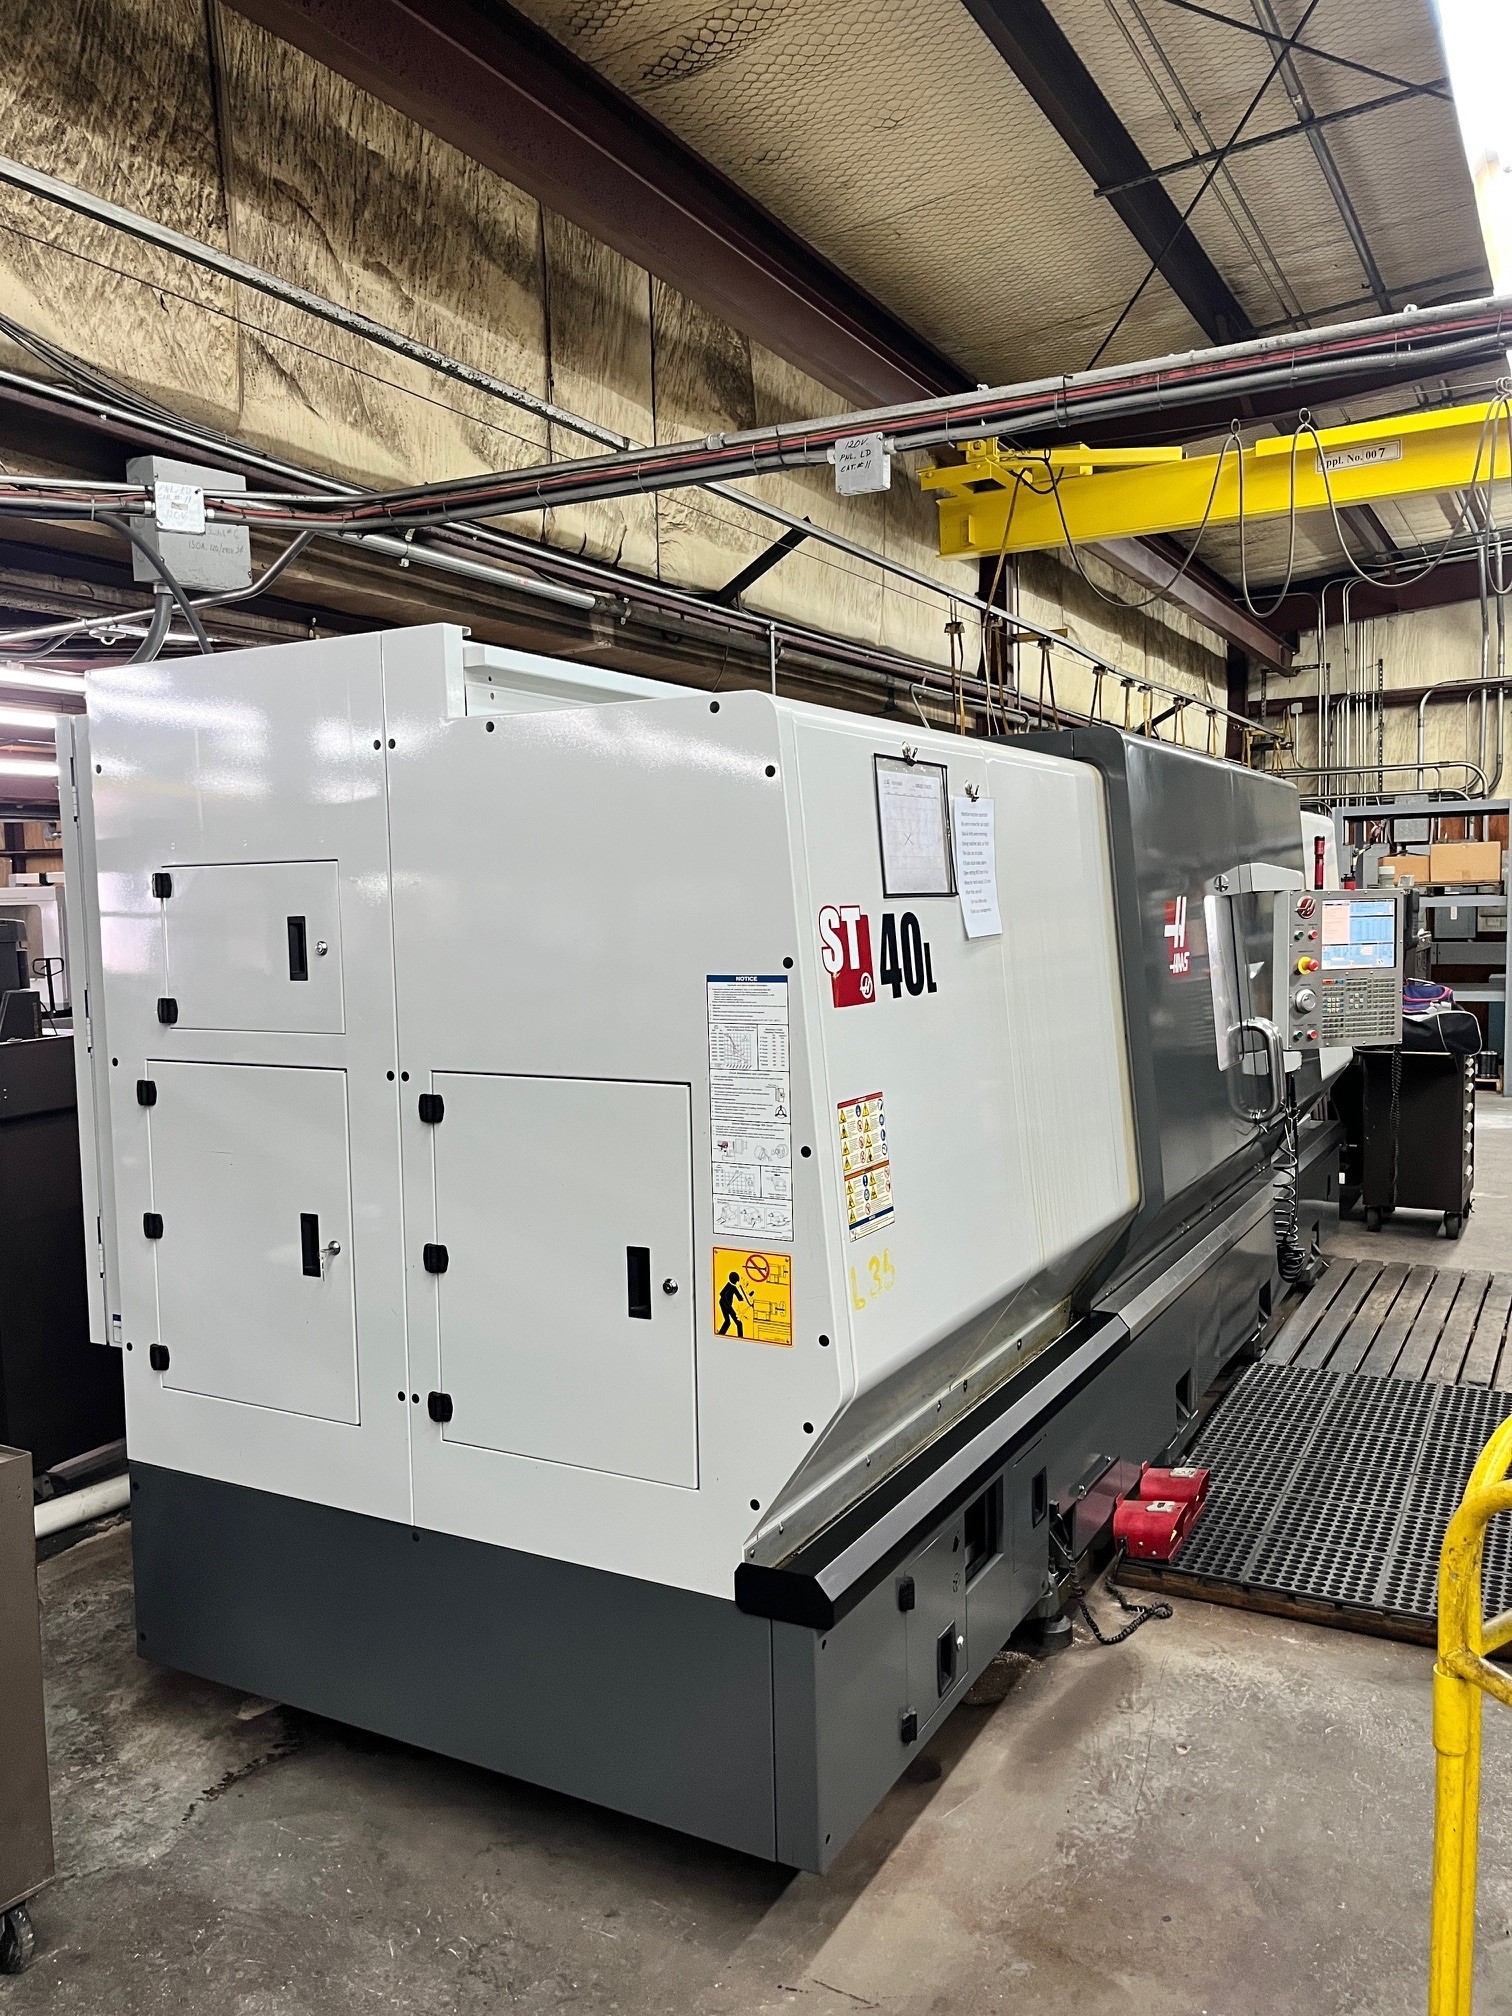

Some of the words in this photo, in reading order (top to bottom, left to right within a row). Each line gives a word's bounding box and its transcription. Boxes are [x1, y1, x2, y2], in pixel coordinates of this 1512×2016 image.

[845, 438, 868, 449] 120V
[860, 449, 871, 458] LD
[1346, 453, 1363, 463] No.
[1365, 447, 1386, 460] 007
[818, 904, 861, 976] ST
